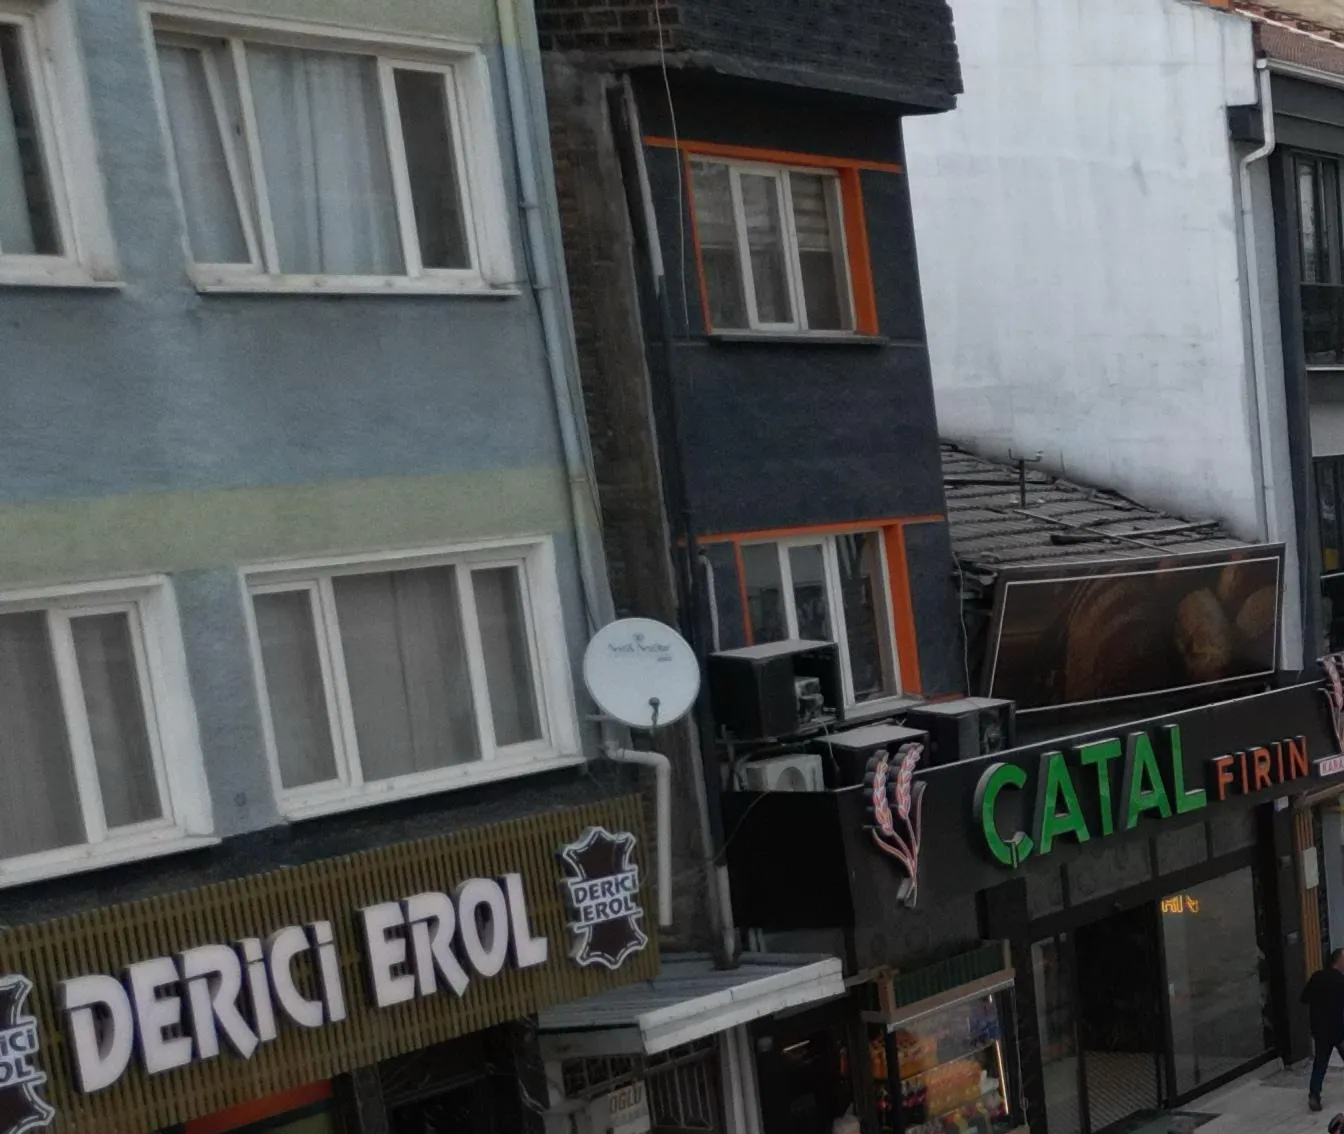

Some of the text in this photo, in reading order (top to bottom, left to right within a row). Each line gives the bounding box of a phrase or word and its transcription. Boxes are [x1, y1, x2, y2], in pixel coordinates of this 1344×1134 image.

[978, 724, 1309, 870] ÇATAL FIRIN
[360, 873, 548, 1008] EROL
[583, 898, 634, 922] EROL
